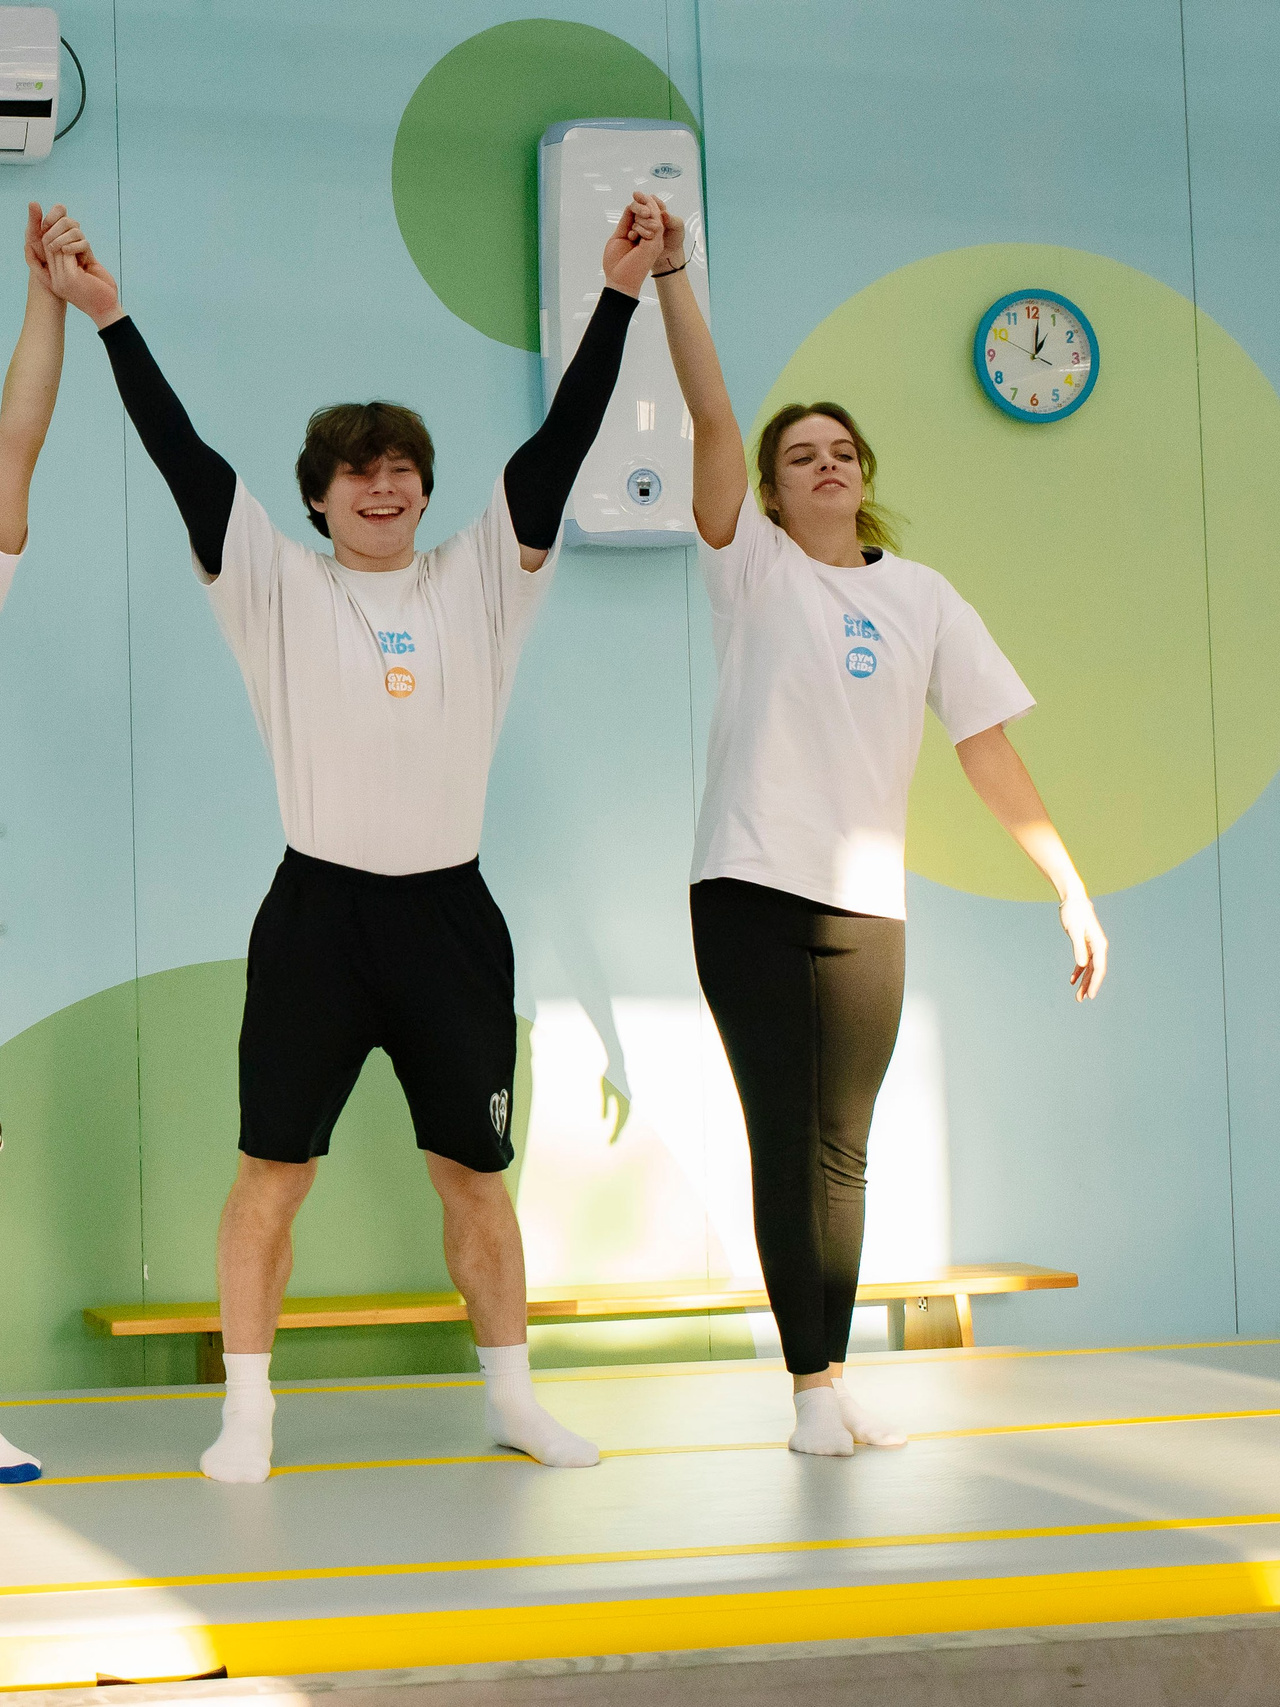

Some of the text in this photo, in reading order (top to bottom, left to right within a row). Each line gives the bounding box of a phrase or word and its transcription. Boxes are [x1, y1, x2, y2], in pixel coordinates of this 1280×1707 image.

[1006, 312, 1017, 325] 11
[1025, 305, 1039, 319] 12
[1051, 313, 1056, 327] 1
[992, 328, 1008, 341] 10
[1066, 330, 1074, 343] 2
[987, 349, 996, 362] 9
[1071, 352, 1080, 365] 3
[995, 370, 1003, 384] 8
[1064, 373, 1073, 386] 4
[1010, 387, 1018, 401] 7
[1030, 393, 1039, 406] 6
[1051, 388, 1059, 402] 5
[848, 653, 874, 664] GYM
[387, 673, 412, 683] GYM
